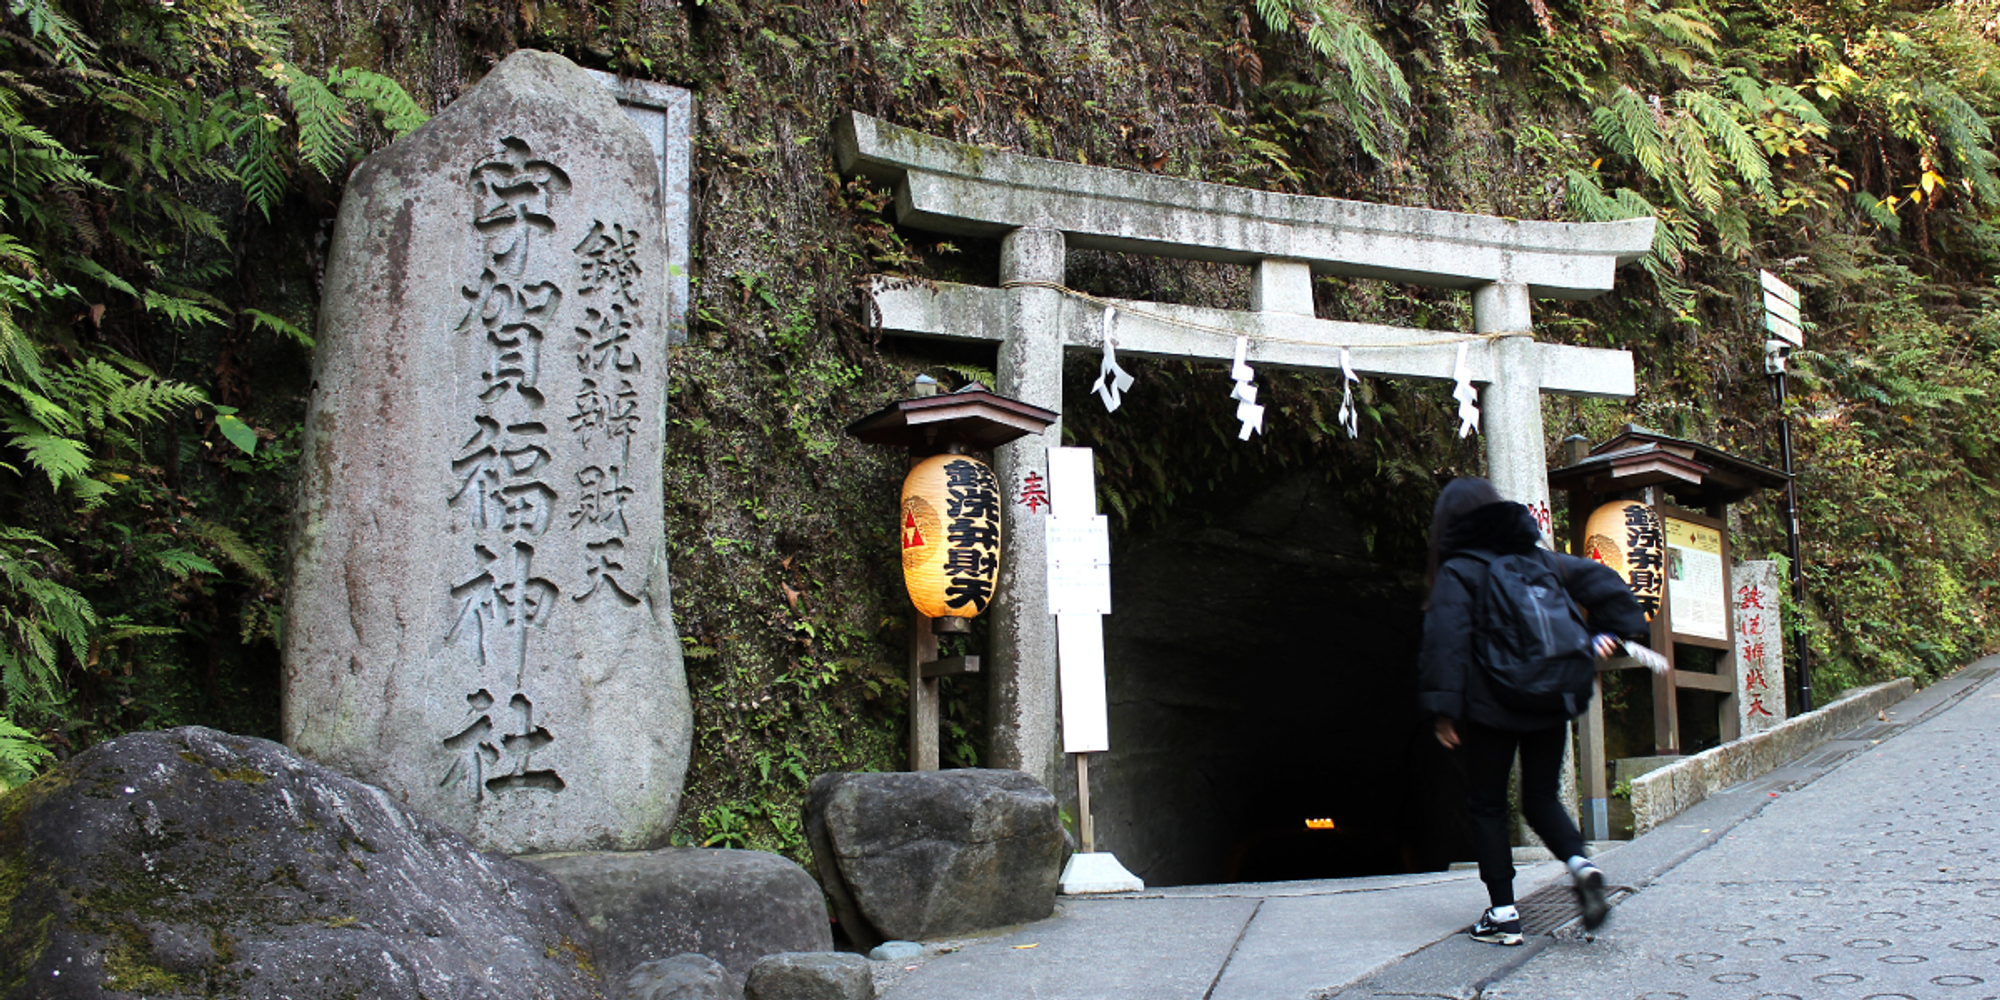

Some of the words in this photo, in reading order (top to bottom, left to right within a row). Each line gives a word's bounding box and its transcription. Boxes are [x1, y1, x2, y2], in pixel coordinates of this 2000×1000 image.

[439, 136, 572, 801] 宇賀福神社
[1017, 471, 1049, 515] 奉
